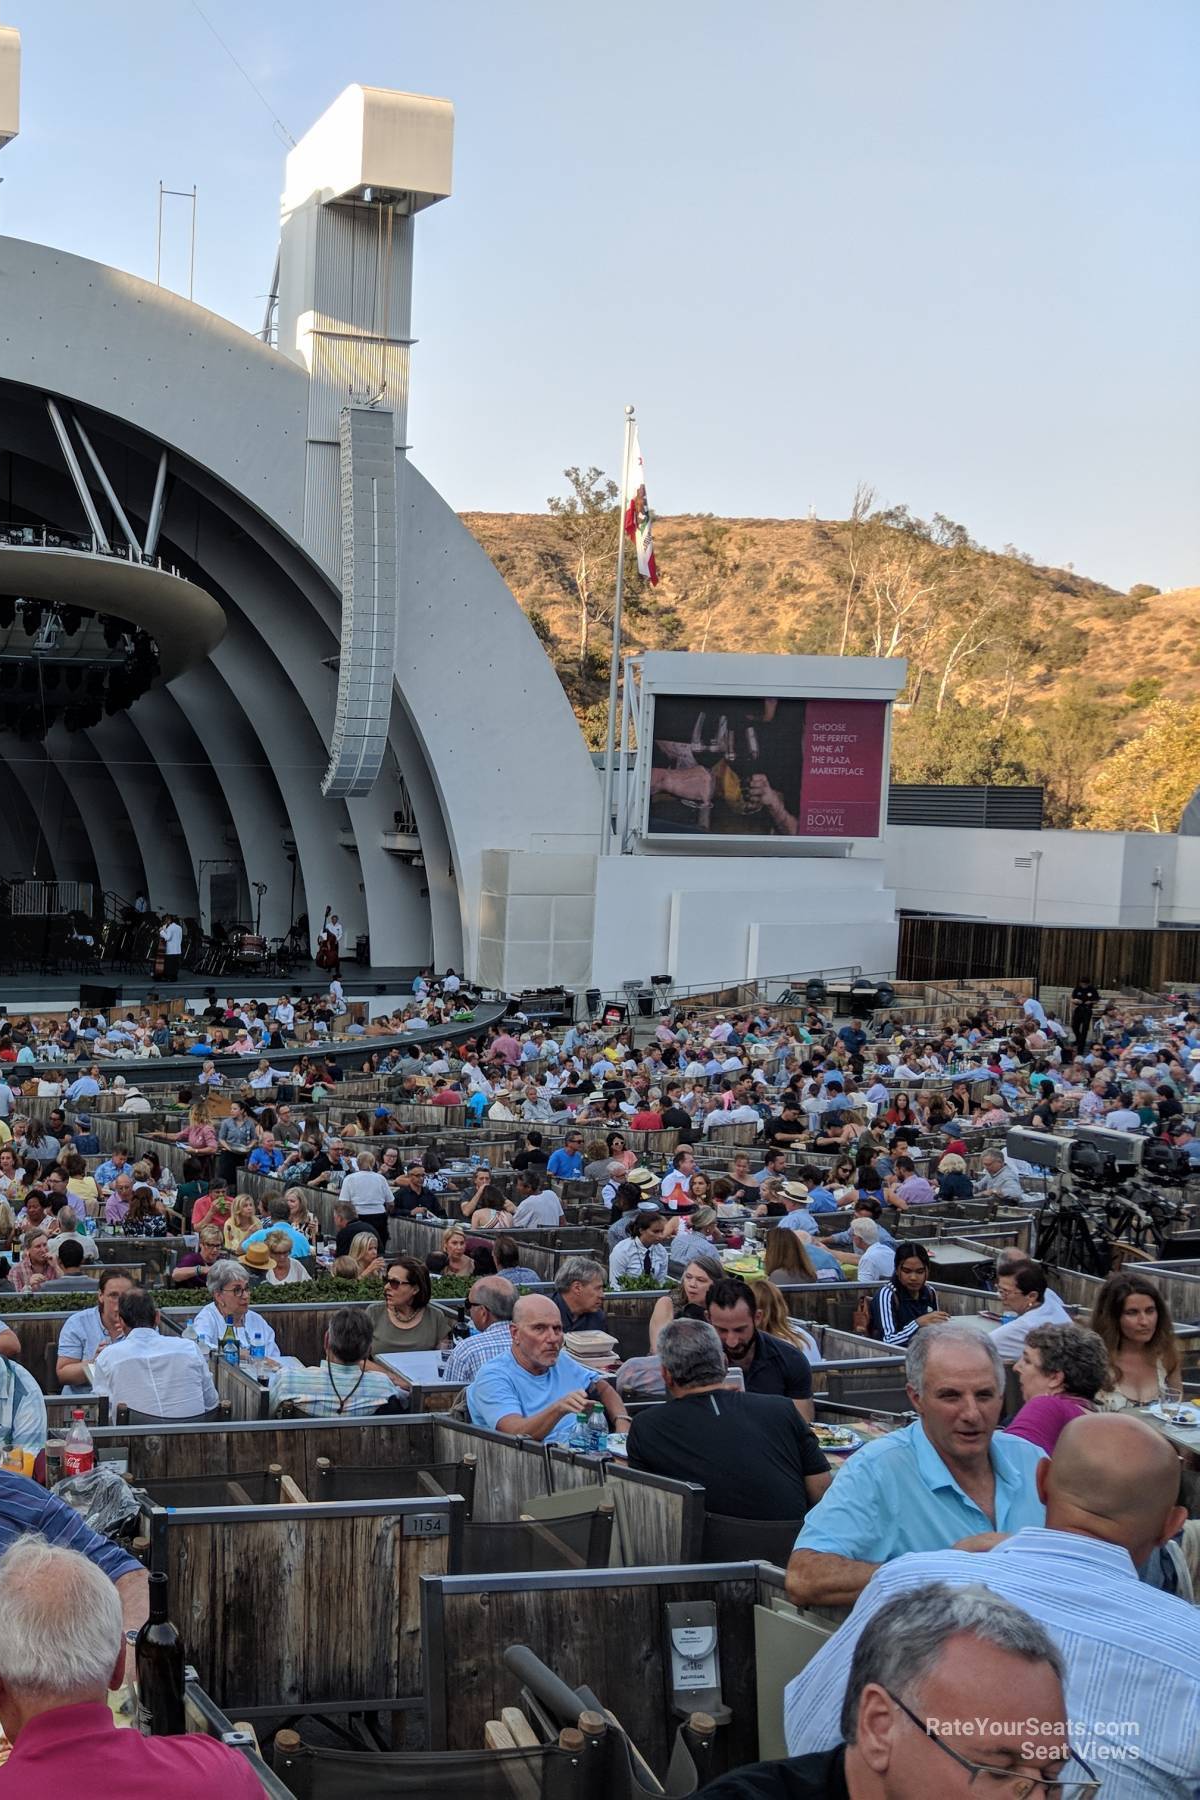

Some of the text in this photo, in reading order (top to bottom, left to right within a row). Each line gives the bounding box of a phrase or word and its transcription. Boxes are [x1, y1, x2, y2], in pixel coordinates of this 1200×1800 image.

[813, 723, 846, 731] CHOOSE
[812, 733, 857, 743] THE PERFECT
[811, 744, 845, 753] WINE AT
[811, 755, 850, 764] THE PLAZA
[810, 767, 865, 776] MARKETPLACE
[807, 814, 844, 826] BOWL
[413, 1519, 441, 1531] 1154
